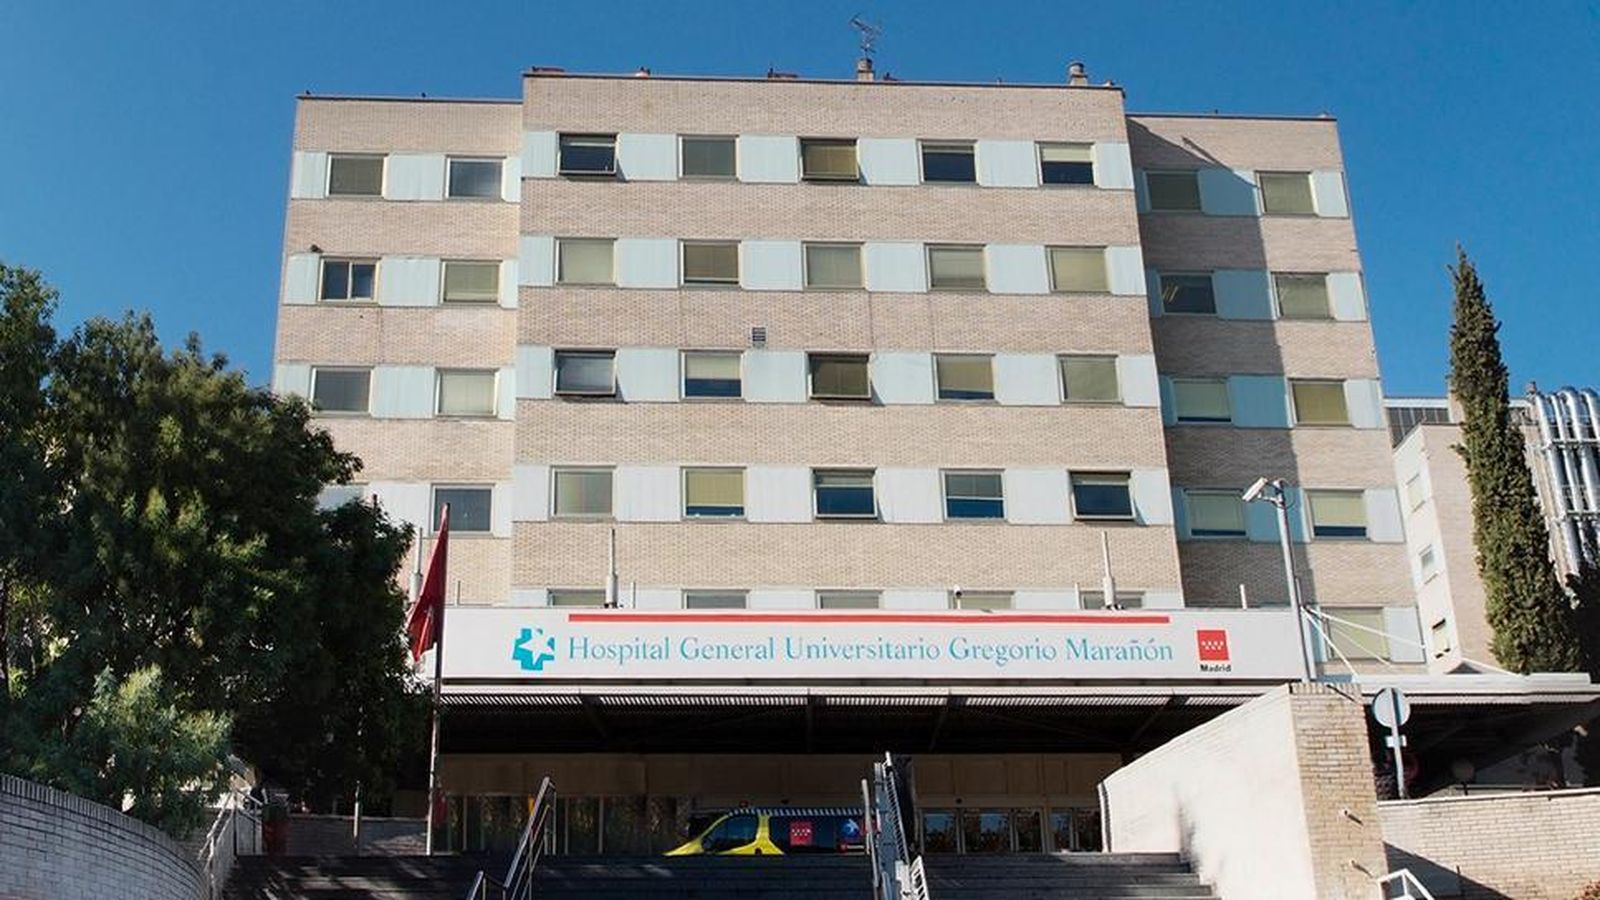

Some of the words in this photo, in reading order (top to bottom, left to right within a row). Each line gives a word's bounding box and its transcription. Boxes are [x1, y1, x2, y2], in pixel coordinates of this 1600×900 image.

[568, 636, 670, 665] Hospital
[679, 636, 776, 660] General
[785, 637, 940, 661] Universitario
[948, 637, 1057, 667] Gregorio
[1066, 637, 1174, 661] Marañón
[1200, 664, 1232, 672] Madrid
